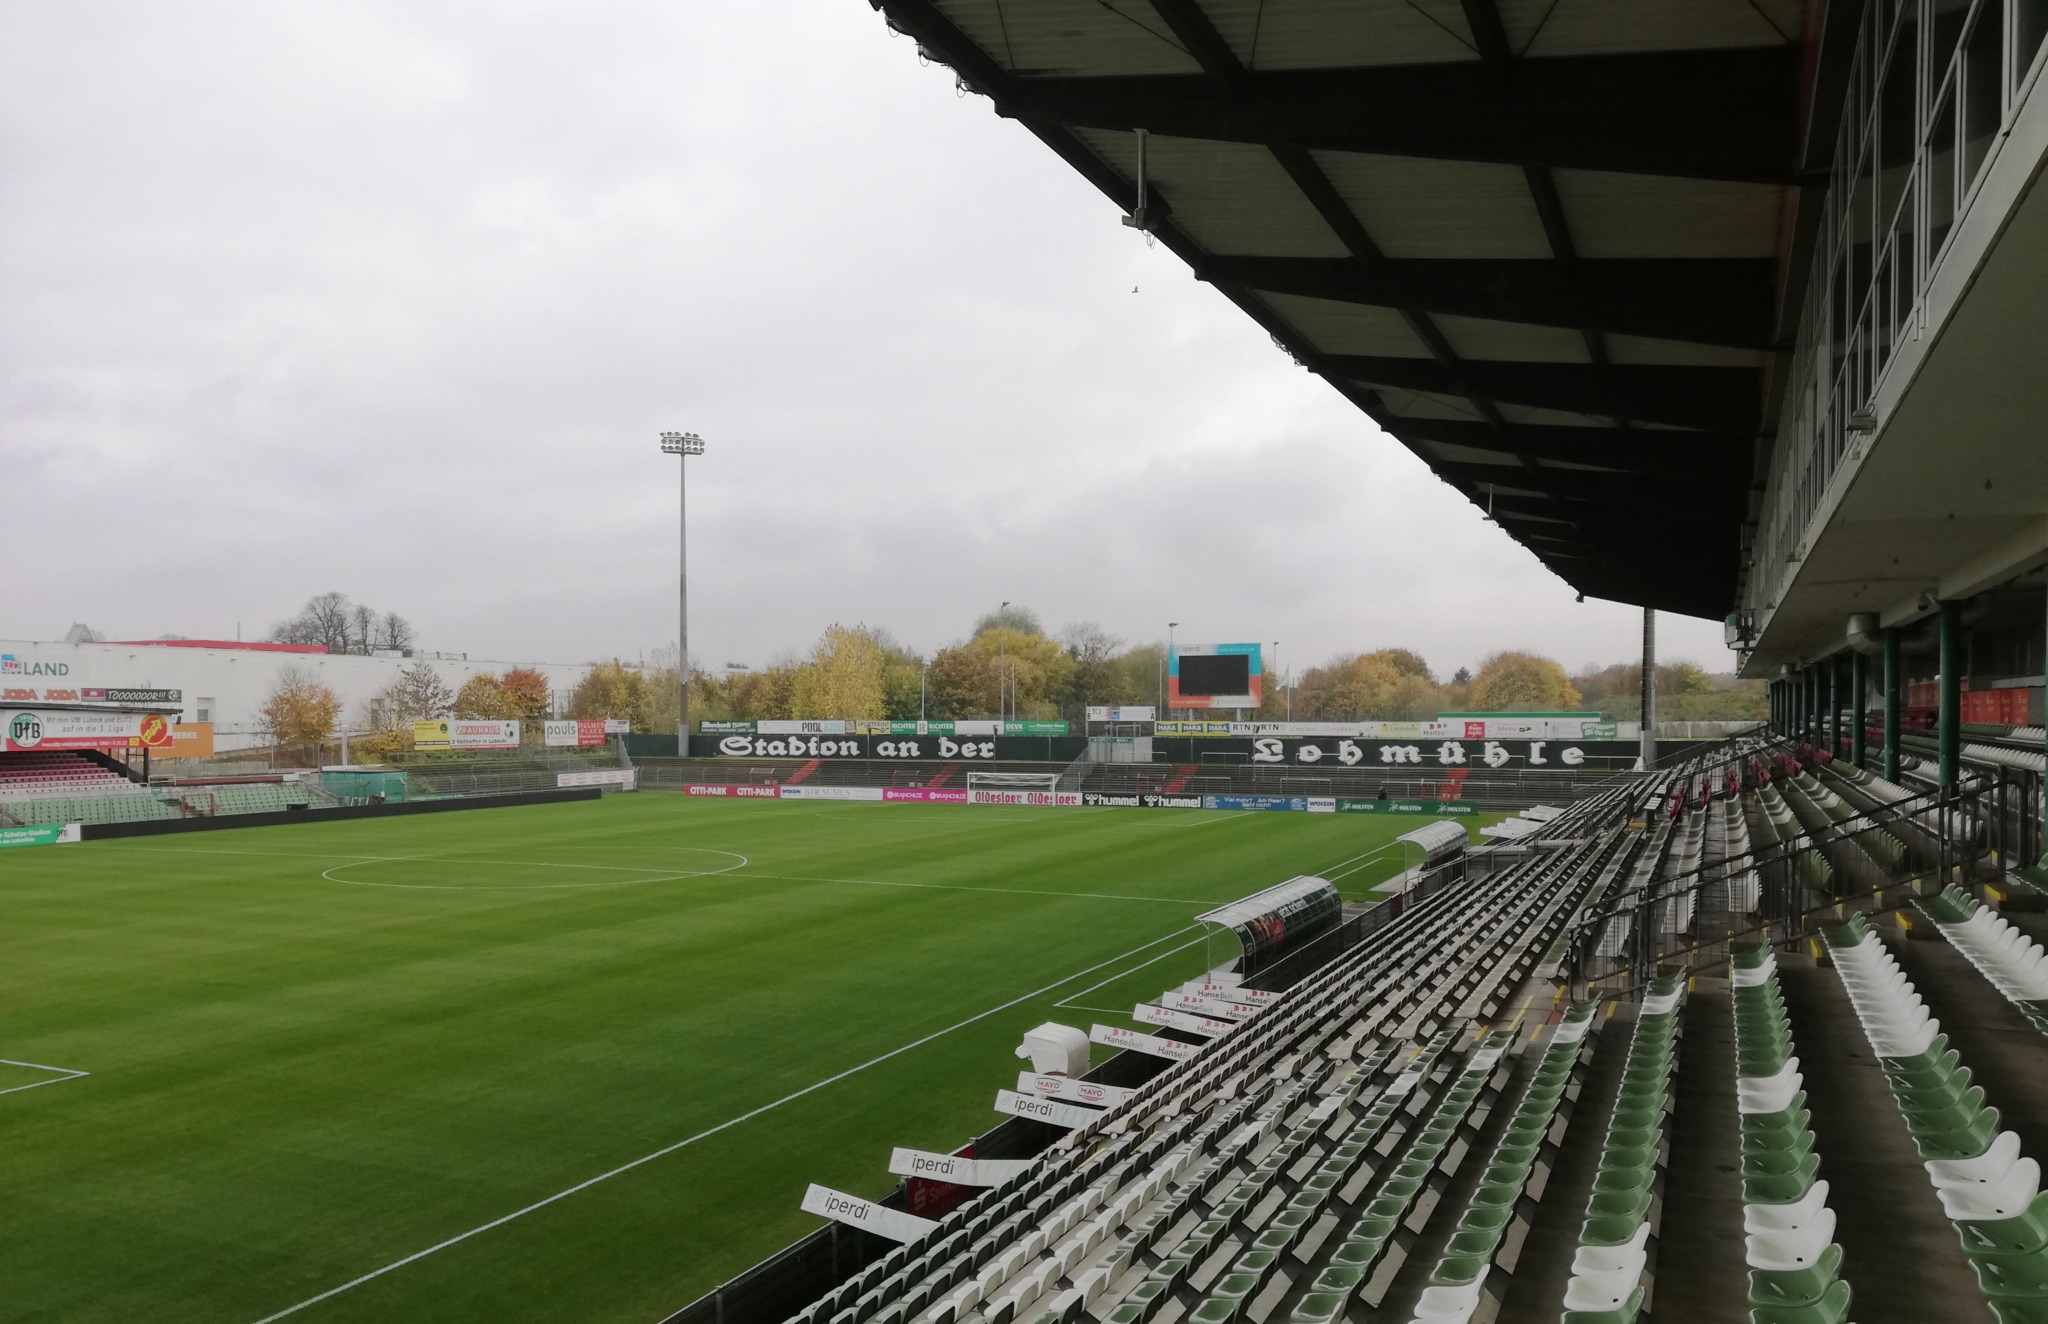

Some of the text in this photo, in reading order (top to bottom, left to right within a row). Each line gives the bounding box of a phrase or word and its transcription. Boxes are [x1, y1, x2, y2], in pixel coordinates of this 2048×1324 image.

[24, 662, 69, 676] LAND
[108, 724, 124, 733] Liga
[461, 726, 500, 734] BAUHAUS
[546, 722, 576, 739] pauls
[720, 736, 860, 756] Stadion
[877, 742, 921, 758] an
[938, 737, 994, 758] der
[690, 786, 775, 796] CITTI-PARK CITTI-PARK
[804, 788, 820, 796] BTR
[975, 792, 1022, 804] Oldesloer
[1099, 796, 1140, 806] hummel
[1158, 796, 1200, 808] hummel
[1104, 1034, 1144, 1050] HanseBelt
[1038, 1081, 1103, 1096] MAYO MAYO
[1014, 1096, 1054, 1116] iperdi
[912, 1154, 955, 1174] iperdi
[824, 1192, 870, 1220] iperdi
